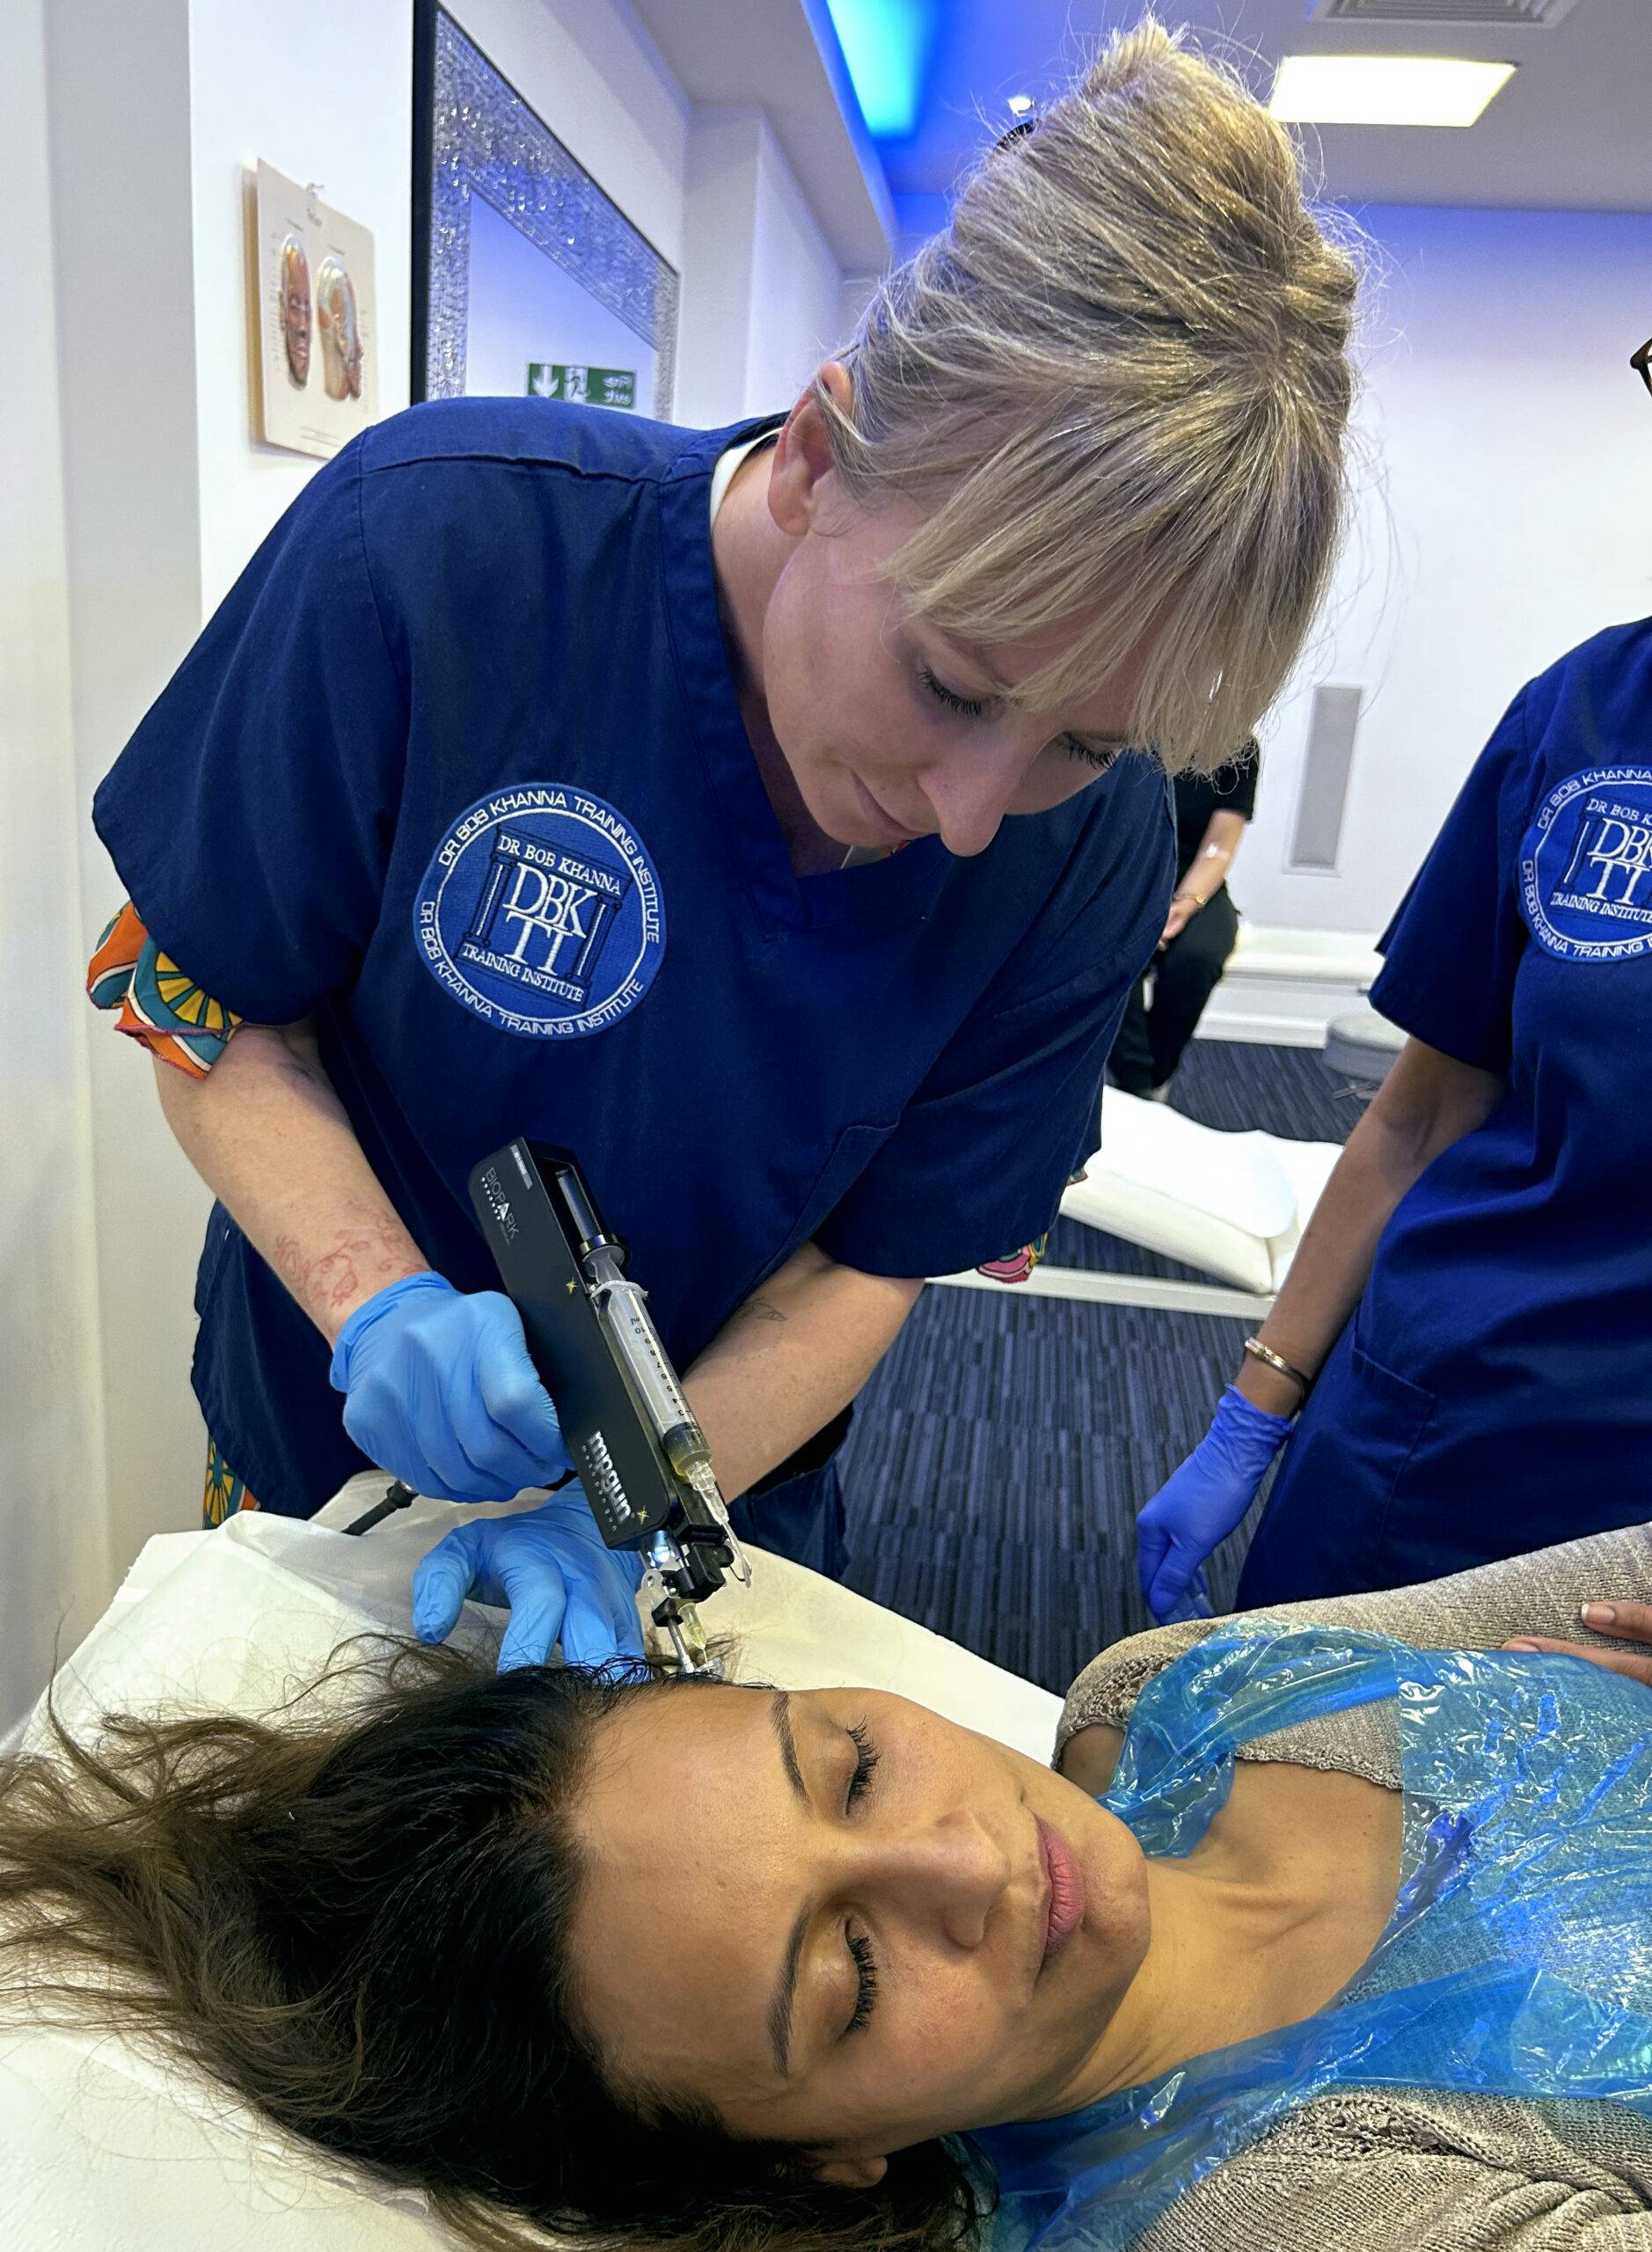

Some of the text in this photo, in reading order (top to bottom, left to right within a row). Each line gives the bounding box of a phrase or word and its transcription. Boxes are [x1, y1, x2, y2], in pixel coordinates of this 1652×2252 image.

[1537, 768, 1652, 830] DR BOB KHANNA
[1586, 798, 1608, 815] DR
[1610, 804, 1640, 821] BOB
[438, 790, 660, 944] DR BOB KHANNA TRAINING INSTITUTE
[497, 834, 622, 896] DR BOB KHANNA
[1522, 859, 1535, 883] DR
[502, 861, 599, 940] DBK
[1524, 884, 1539, 916] BOB
[1550, 891, 1601, 915] TRAINING
[1531, 912, 1569, 954] KHANNA
[1572, 940, 1645, 958] TRAINING
[420, 901, 644, 1035] DR BOB KHANNA TRAINING INSTITUTE
[462, 942, 585, 1002] TRAINING INSTITUTE
[588, 1430, 632, 1524] mpgun
